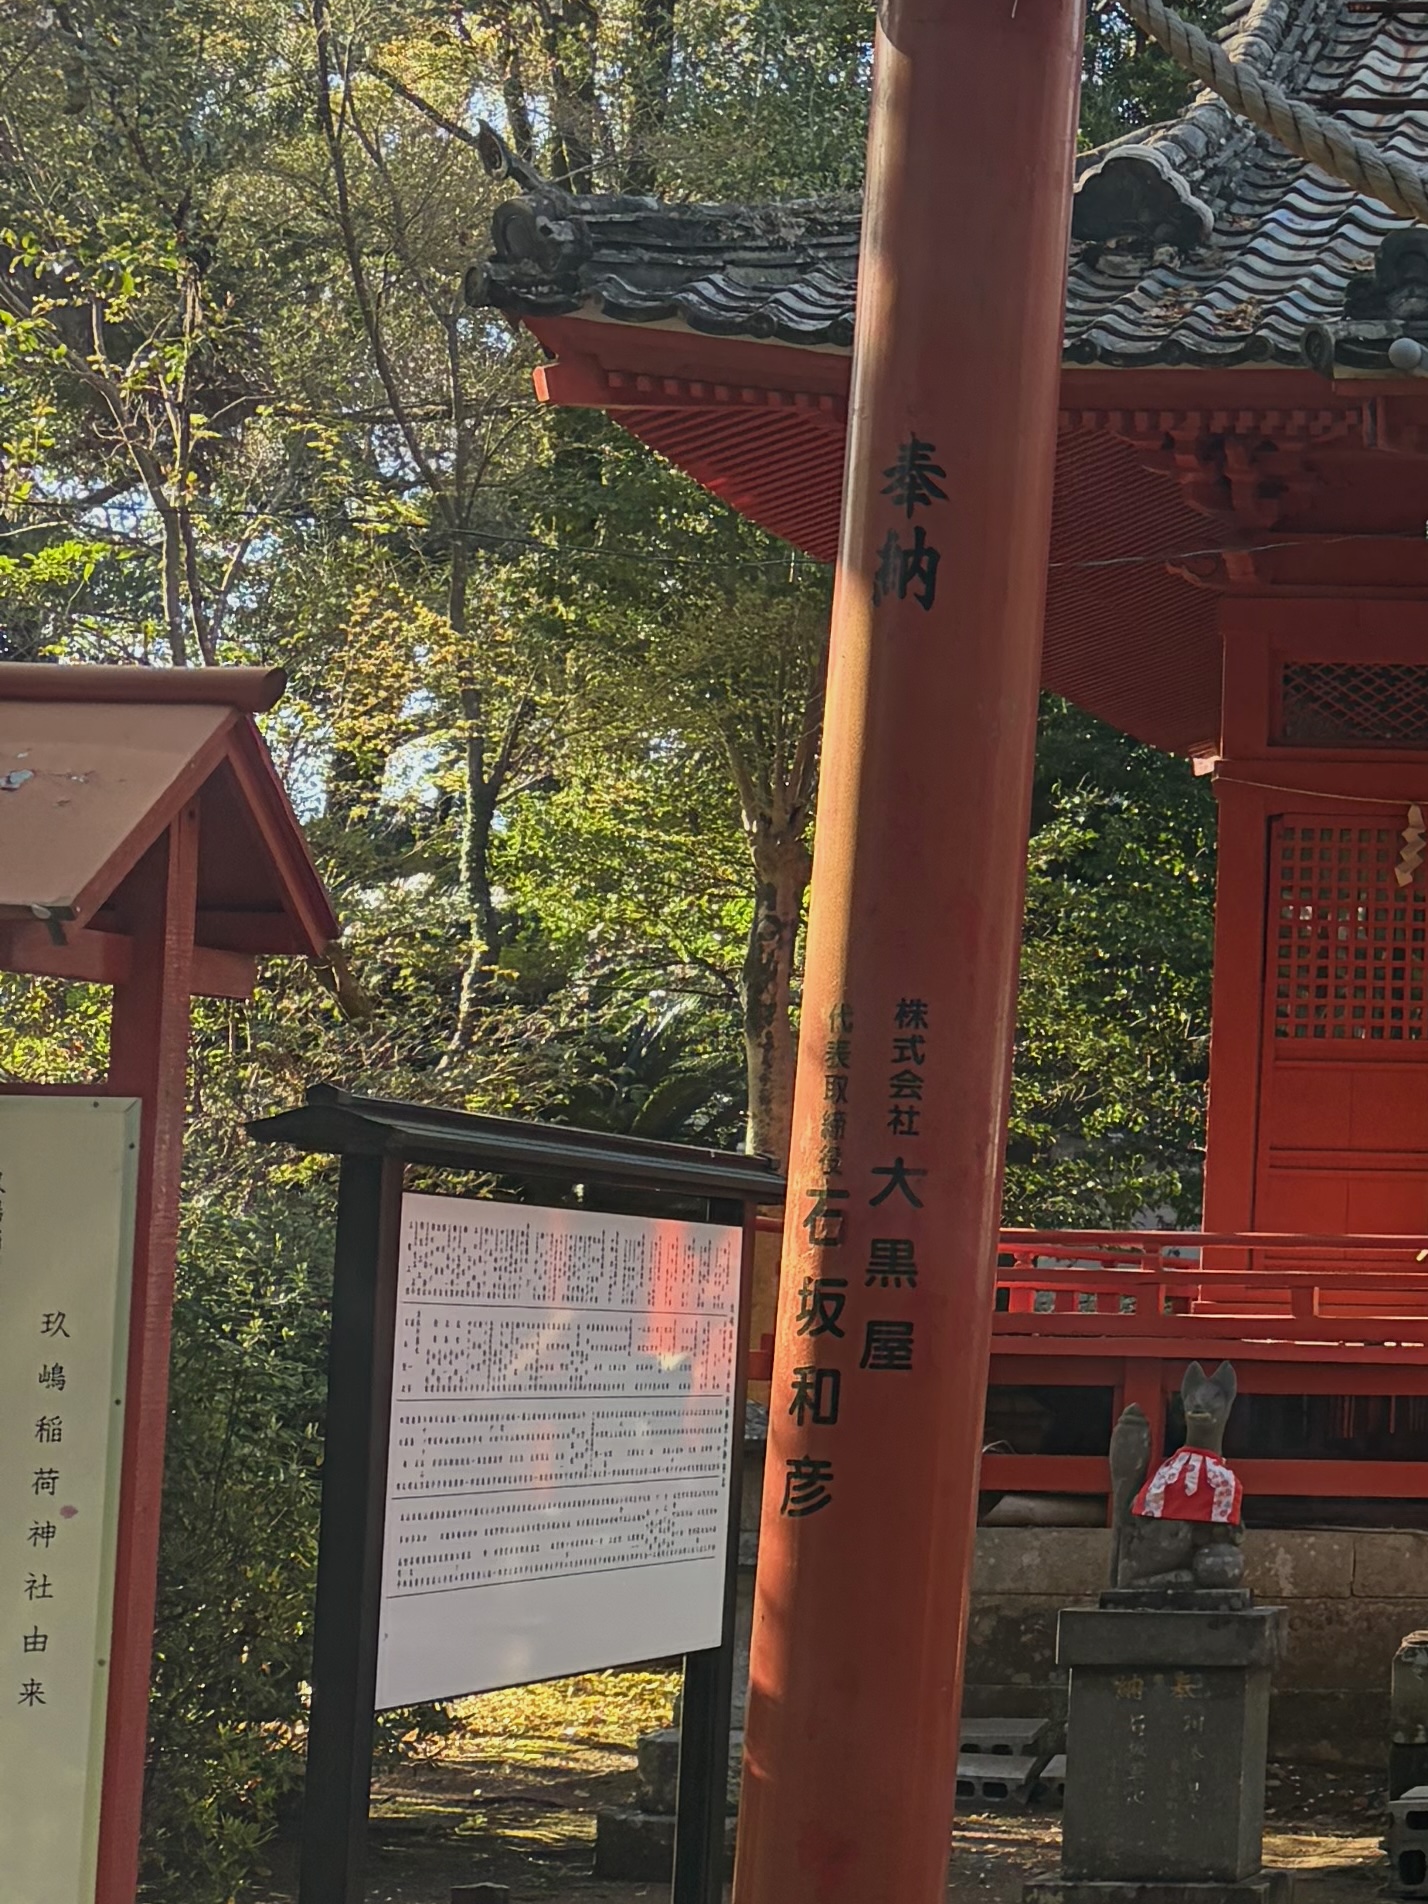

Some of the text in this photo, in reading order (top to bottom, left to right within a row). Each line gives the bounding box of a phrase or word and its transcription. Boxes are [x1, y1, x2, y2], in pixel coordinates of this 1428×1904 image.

[872, 431, 950, 612] 奉納
[859, 997, 929, 1371] 株式会社大黒屋
[17, 1310, 71, 1707] 玖嶋稲荷神社由来
